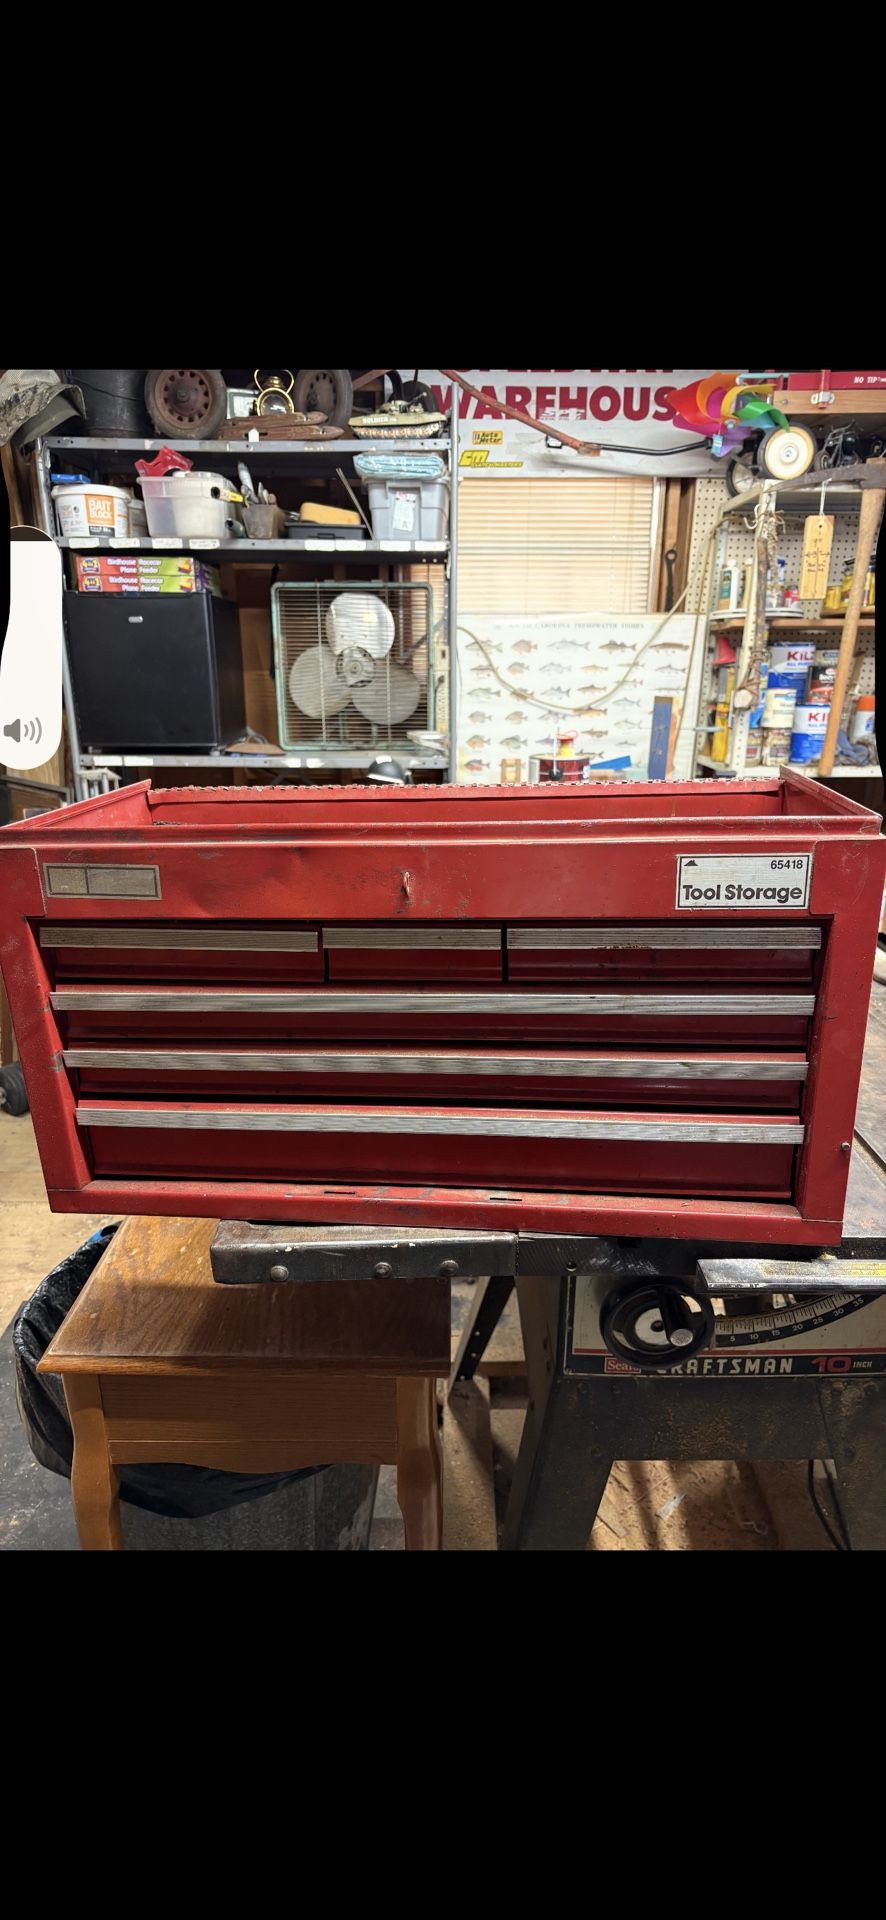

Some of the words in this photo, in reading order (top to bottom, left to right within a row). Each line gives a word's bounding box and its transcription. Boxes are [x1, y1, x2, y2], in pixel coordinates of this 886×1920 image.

[431, 385, 677, 421] WAREHOUS
[89, 499, 112, 510] BAIT
[770, 859, 803, 870] 65418
[682, 884, 721, 900] Tool
[725, 884, 803, 904] Storage
[852, 1297, 864, 1308] 35
[833, 1308, 845, 1317] 30
[812, 1317, 824, 1325] 25
[656, 1359, 793, 1374] RAFTSMAN
[811, 1357, 852, 1373] 10
[853, 1361, 873, 1369] INCH
